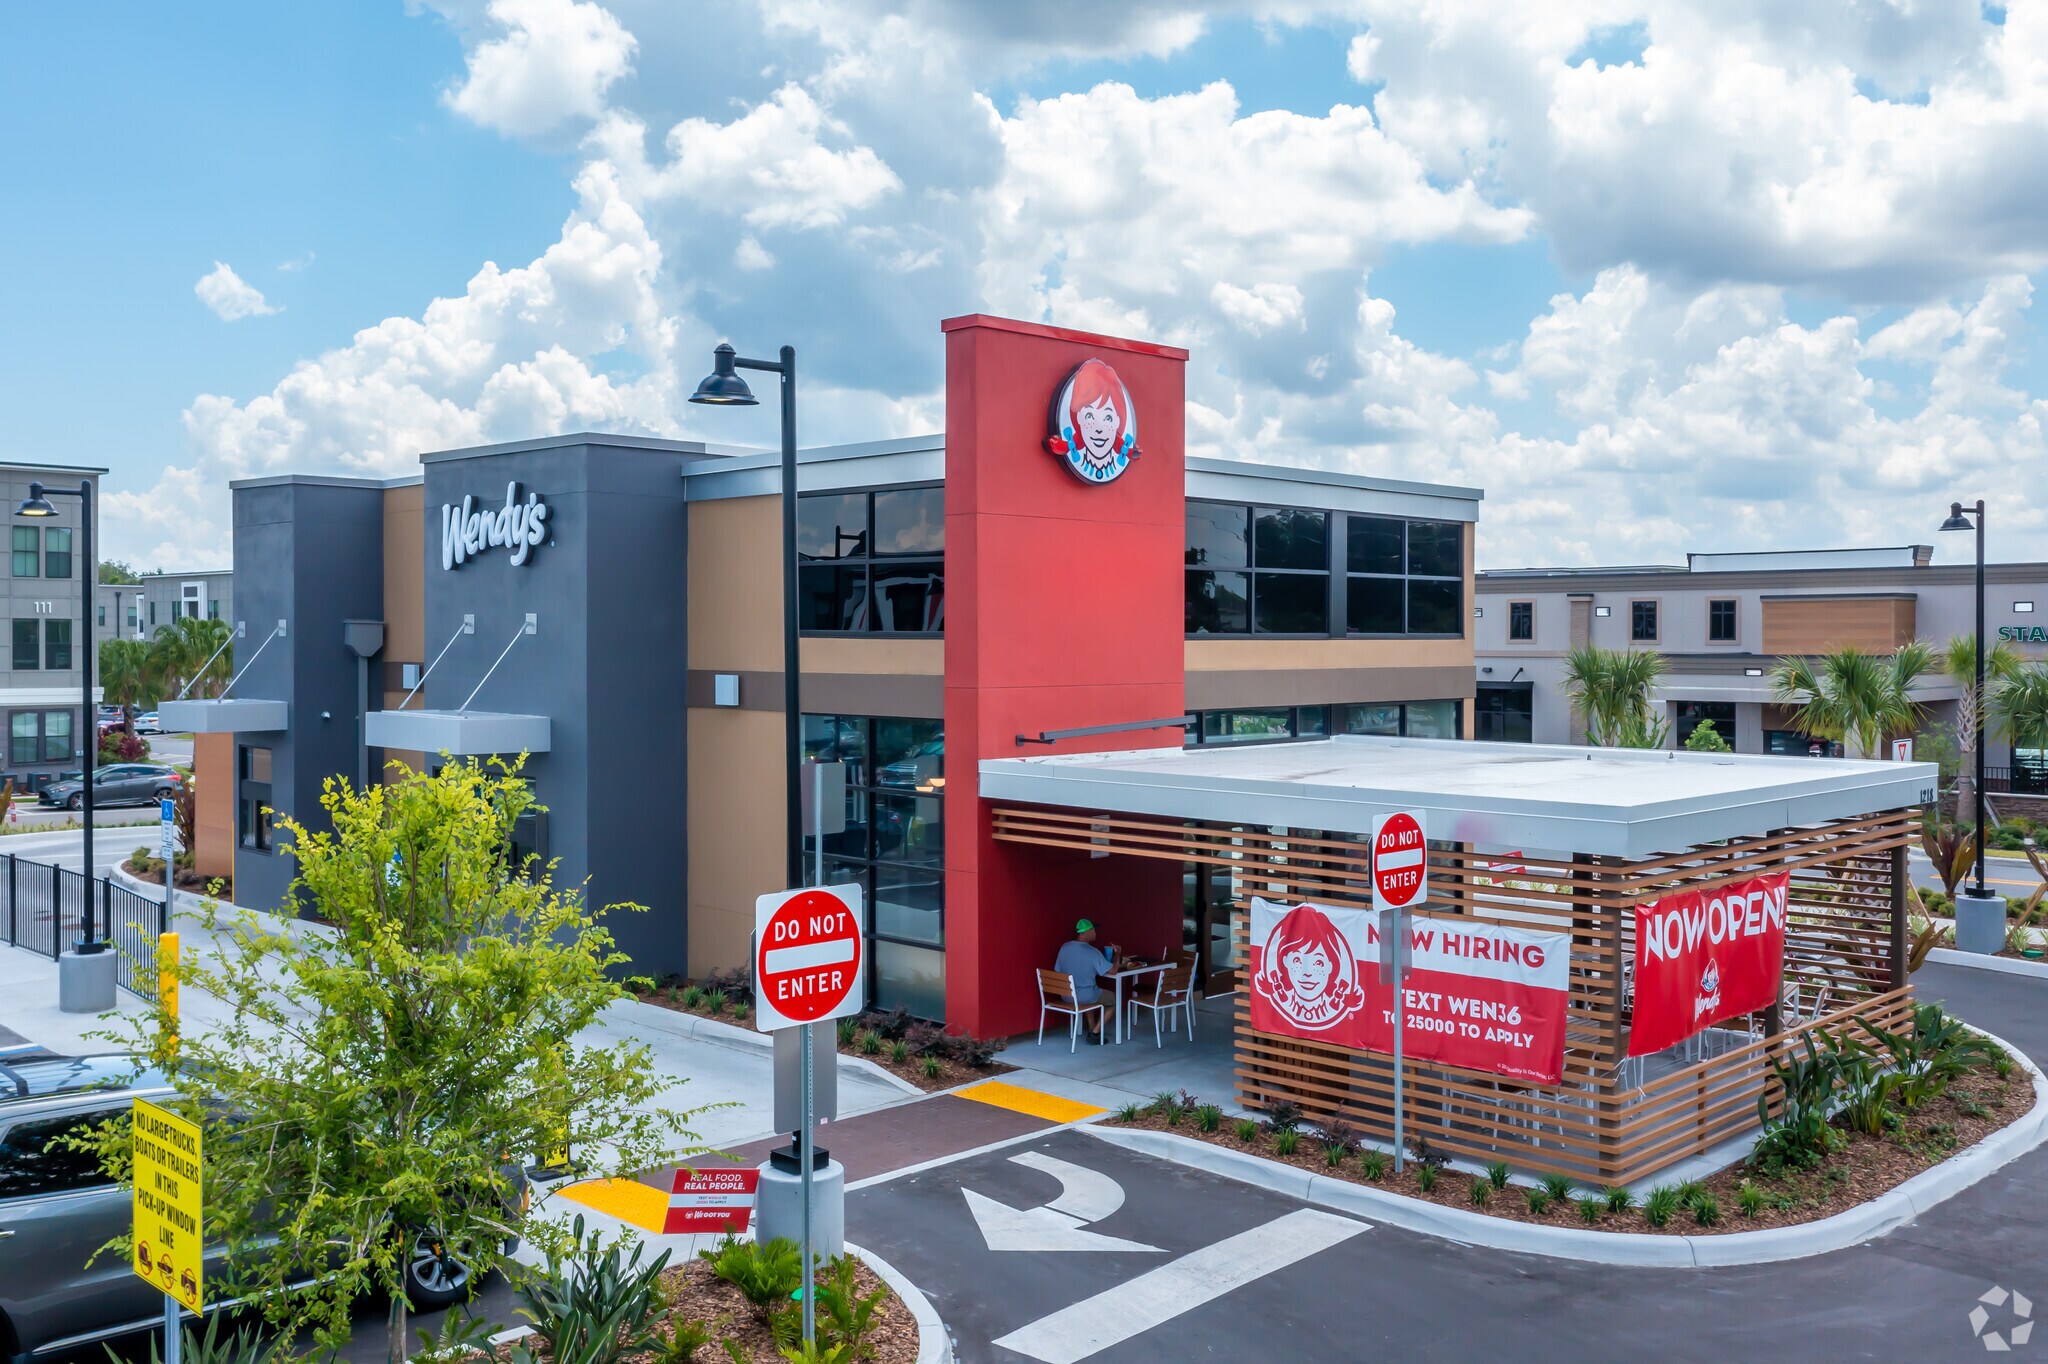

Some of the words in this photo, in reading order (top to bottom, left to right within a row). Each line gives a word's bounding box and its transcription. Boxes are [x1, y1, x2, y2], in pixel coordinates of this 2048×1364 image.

[442, 481, 547, 570] Wendy's
[33, 601, 52, 614] 111
[1381, 833, 1395, 849] DO
[1399, 829, 1419, 846] NOT
[1383, 870, 1417, 890] ENTER
[774, 919, 800, 942] DO
[809, 912, 846, 937] NOT
[1644, 903, 1706, 967] NOW
[1708, 886, 1786, 945] OPEN!
[1368, 923, 1435, 952] NW
[1442, 932, 1545, 968] HIRING
[778, 970, 843, 1000] ENTER
[1401, 988, 1442, 1012] EXT
[1382, 1009, 1396, 1025] T
[1407, 1014, 1455, 1035] 25000
[1459, 1022, 1481, 1039] TO
[1484, 1026, 1534, 1048] APPLY
[136, 1110, 146, 1130] NO
[146, 1115, 168, 1141] LARGE
[169, 1126, 198, 1160] TRUCKS,
[135, 1135, 156, 1161] BOATS
[156, 1146, 166, 1167] OR
[167, 1151, 199, 1184] TRAILERS
[154, 1171, 162, 1191] IN
[163, 1174, 178, 1199] THIS
[683, 1182, 707, 1190] REAL
[709, 1182, 746, 1190] PEOPLE.
[690, 1174, 713, 1182] REAL
[715, 1174, 743, 1182] FOOD.
[138, 1187, 166, 1217] PICK-UP
[166, 1205, 196, 1236] WINDOW
[158, 1225, 174, 1250] LINE
